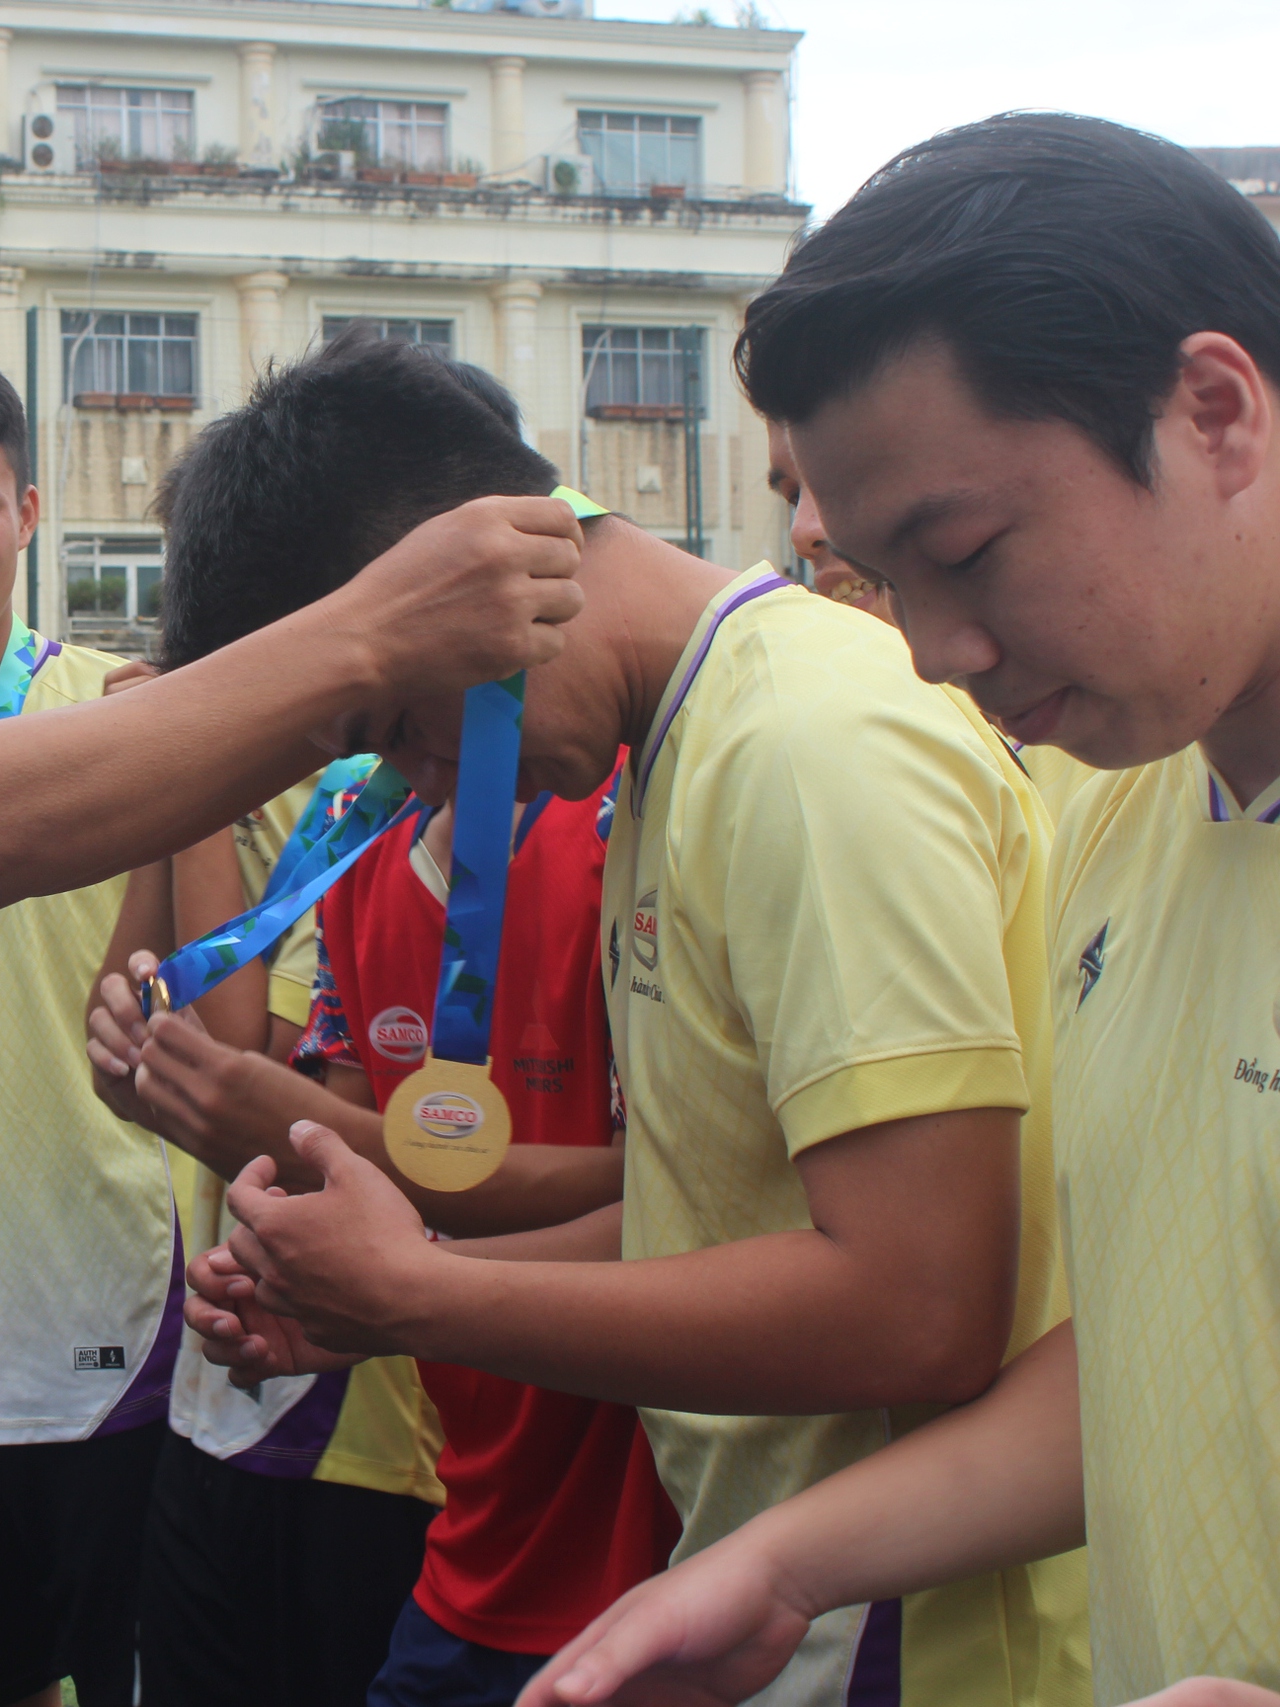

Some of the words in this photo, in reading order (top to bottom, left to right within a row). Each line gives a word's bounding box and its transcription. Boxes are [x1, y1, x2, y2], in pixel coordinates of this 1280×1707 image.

[634, 912, 657, 936] SA
[377, 1027, 424, 1043] SAMCO
[1234, 1057, 1269, 1093] Đồng
[421, 1107, 478, 1123] SAMCO
